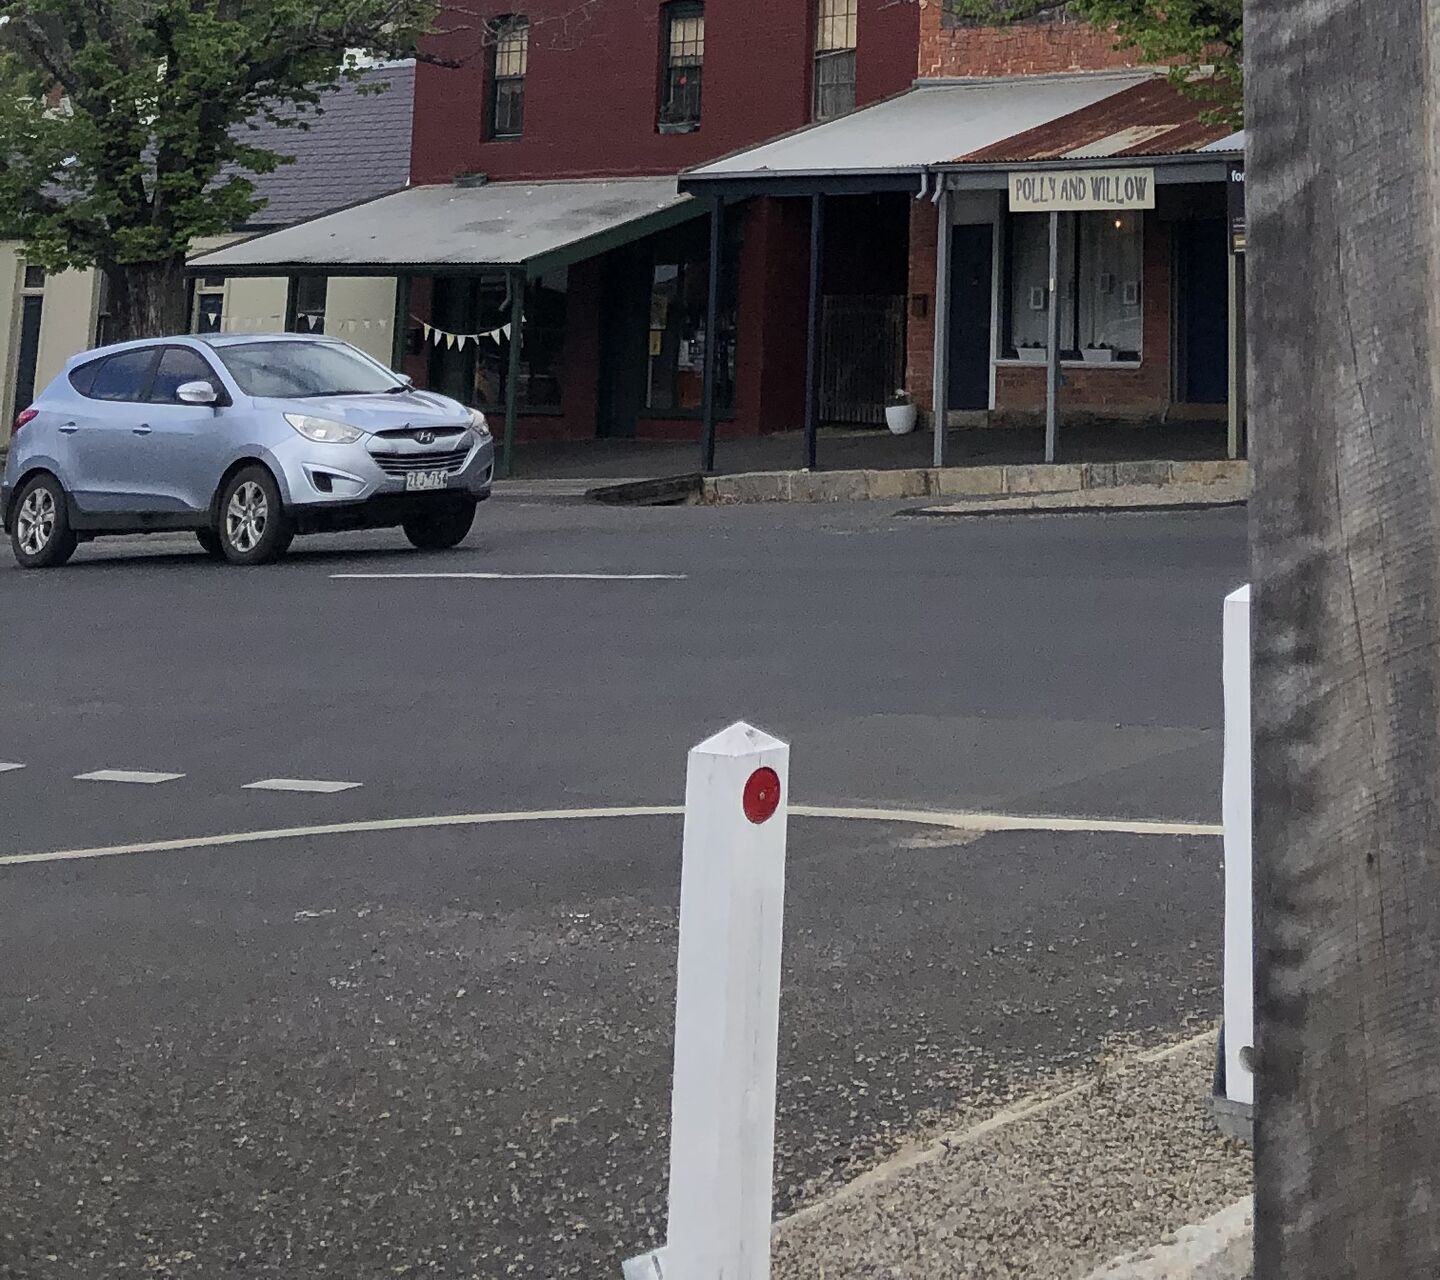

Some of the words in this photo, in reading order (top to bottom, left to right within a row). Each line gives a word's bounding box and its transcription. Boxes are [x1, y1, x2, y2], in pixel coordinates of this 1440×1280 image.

[1015, 176, 1056, 203] POLLY
[1061, 176, 1087, 201] AND
[1090, 176, 1147, 204] WILLOW
